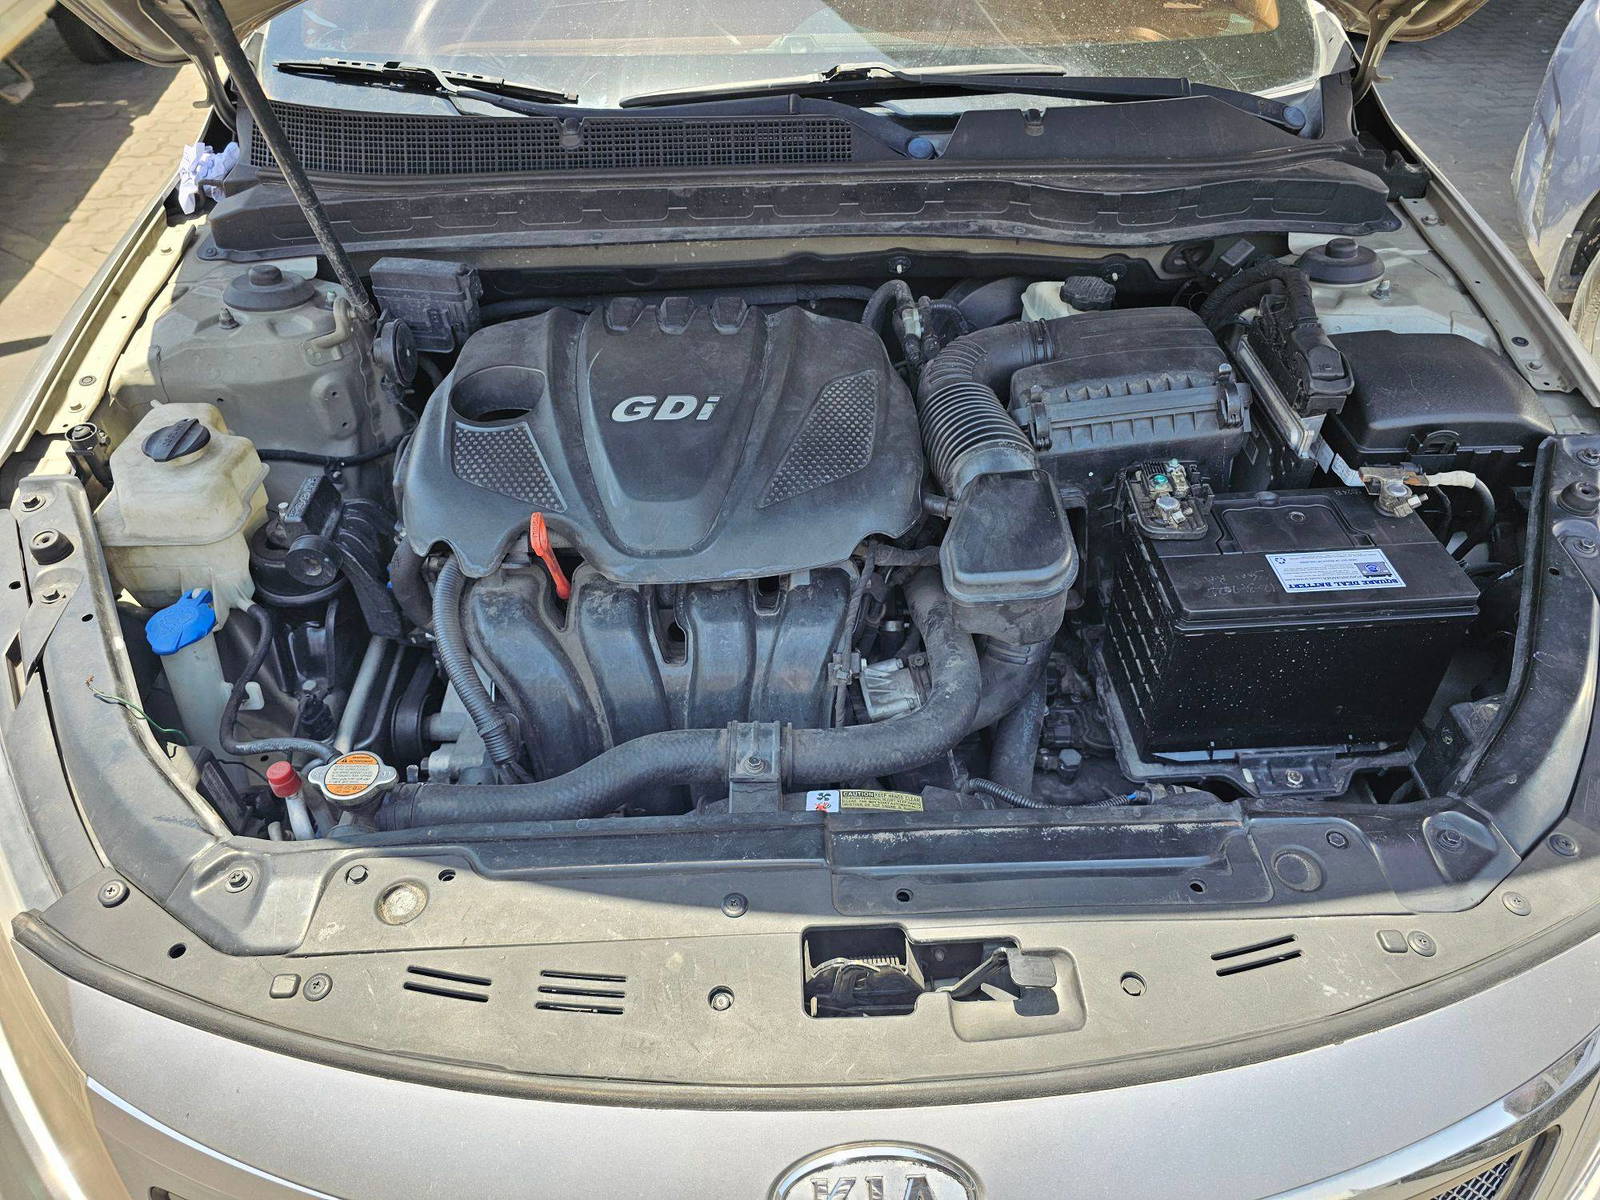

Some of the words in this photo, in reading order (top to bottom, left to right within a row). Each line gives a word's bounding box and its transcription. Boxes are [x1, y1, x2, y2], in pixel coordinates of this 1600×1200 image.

[611, 395, 722, 422] GDi
[1288, 581, 1333, 589] BATTERY
[810, 1175, 936, 1200] KIA
